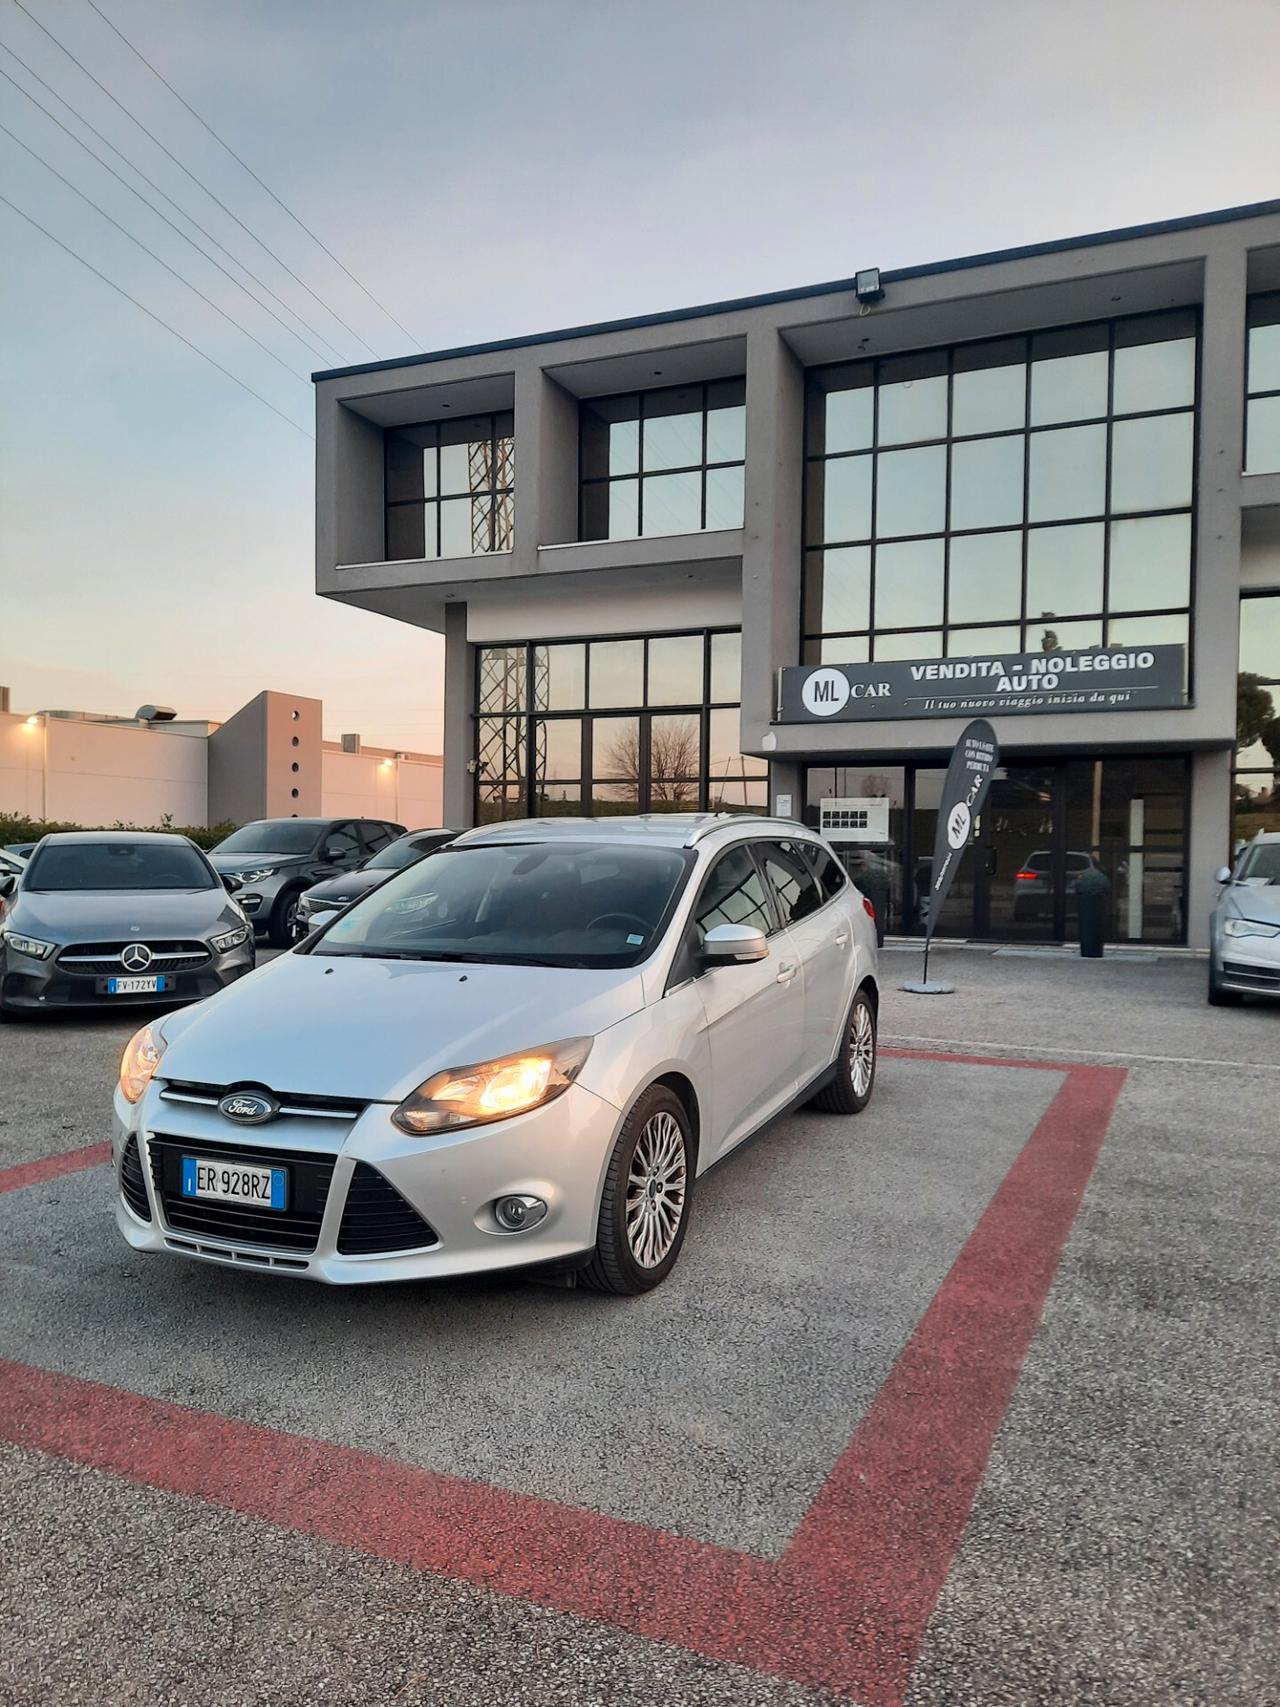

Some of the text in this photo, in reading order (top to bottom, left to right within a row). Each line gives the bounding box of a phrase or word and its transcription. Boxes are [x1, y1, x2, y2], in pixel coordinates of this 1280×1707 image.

[910, 651, 1155, 681] VENDITA - NOLEGGIO
[814, 680, 891, 703] ML CAR
[996, 673, 1059, 692] AUTO
[923, 690, 1131, 710] Il tuo nuovo viaggio inizia da qui
[952, 774, 983, 840] ML CAR
[228, 1098, 258, 1116] Ford
[197, 1166, 271, 1200] ER 928RZ
